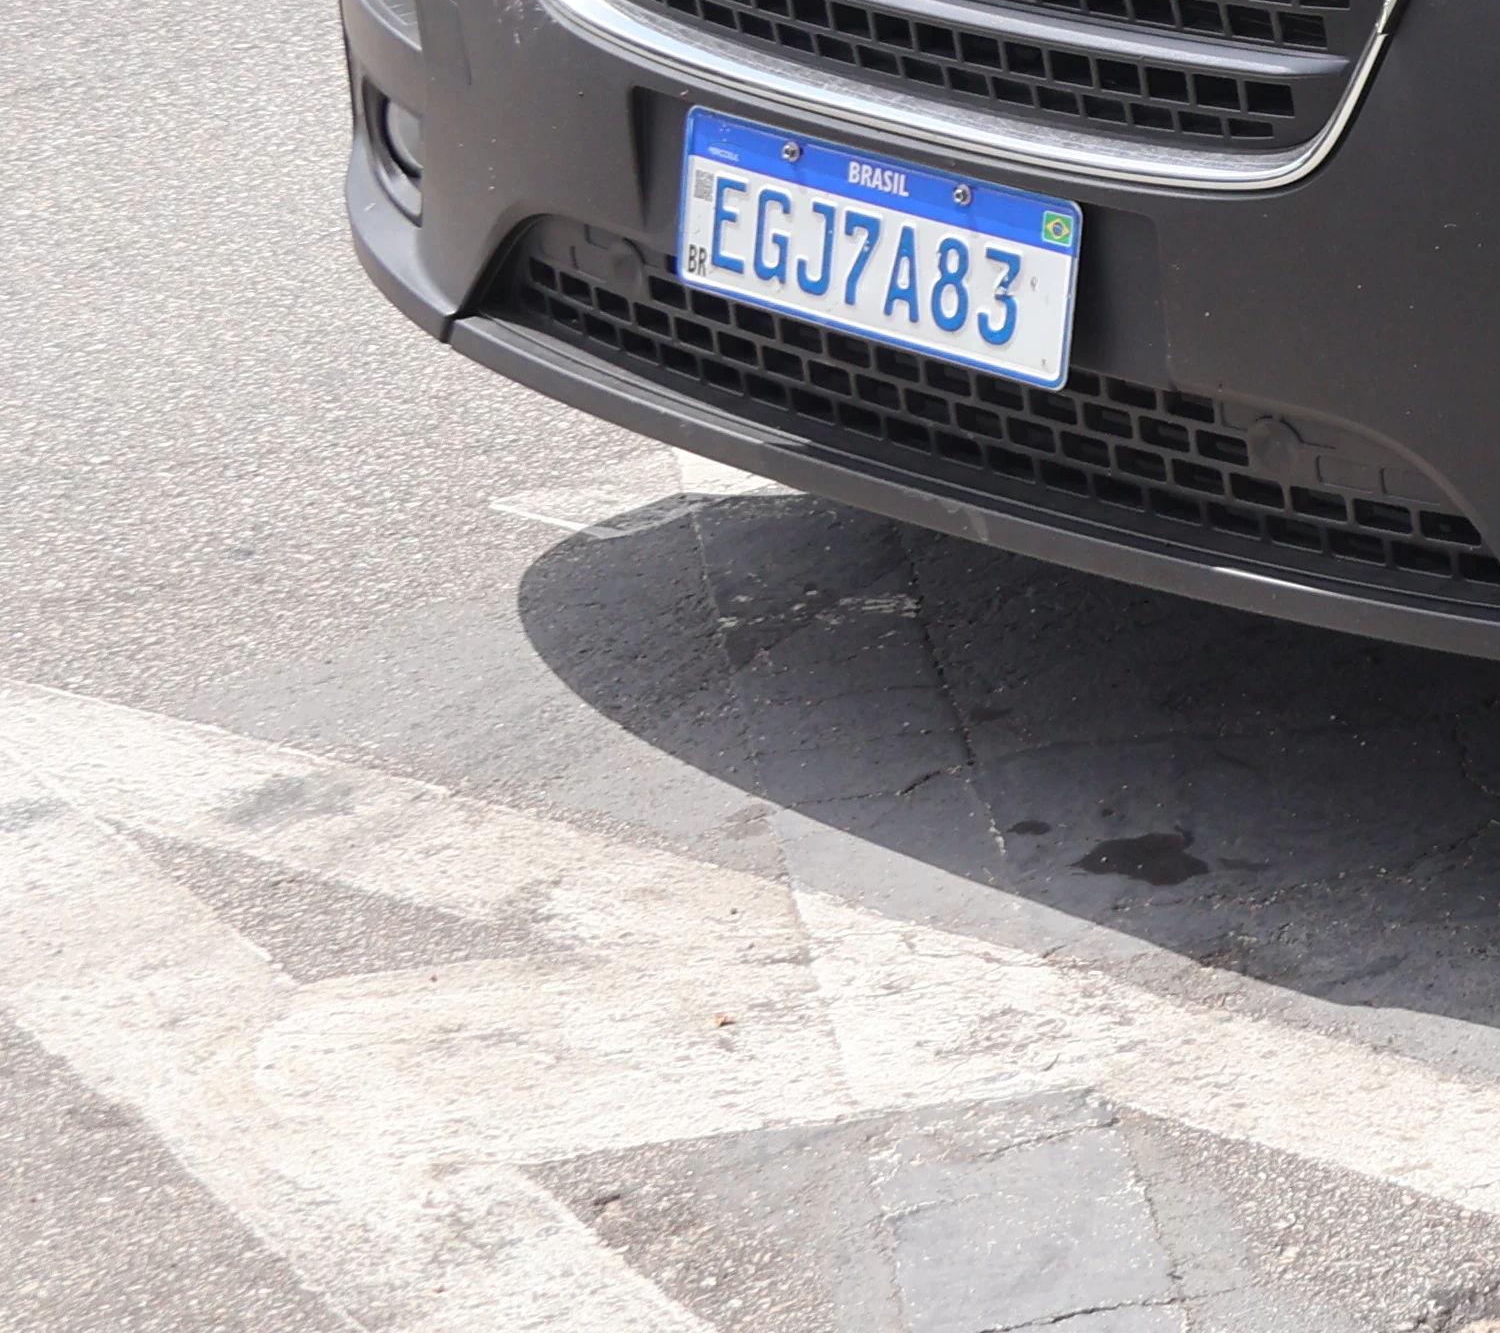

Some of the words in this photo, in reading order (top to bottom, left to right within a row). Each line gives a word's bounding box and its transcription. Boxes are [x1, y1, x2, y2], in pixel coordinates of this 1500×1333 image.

[848, 161, 910, 197] BRASIL
[687, 245, 707, 276] BR
[709, 176, 1022, 346] EGJ7A83
